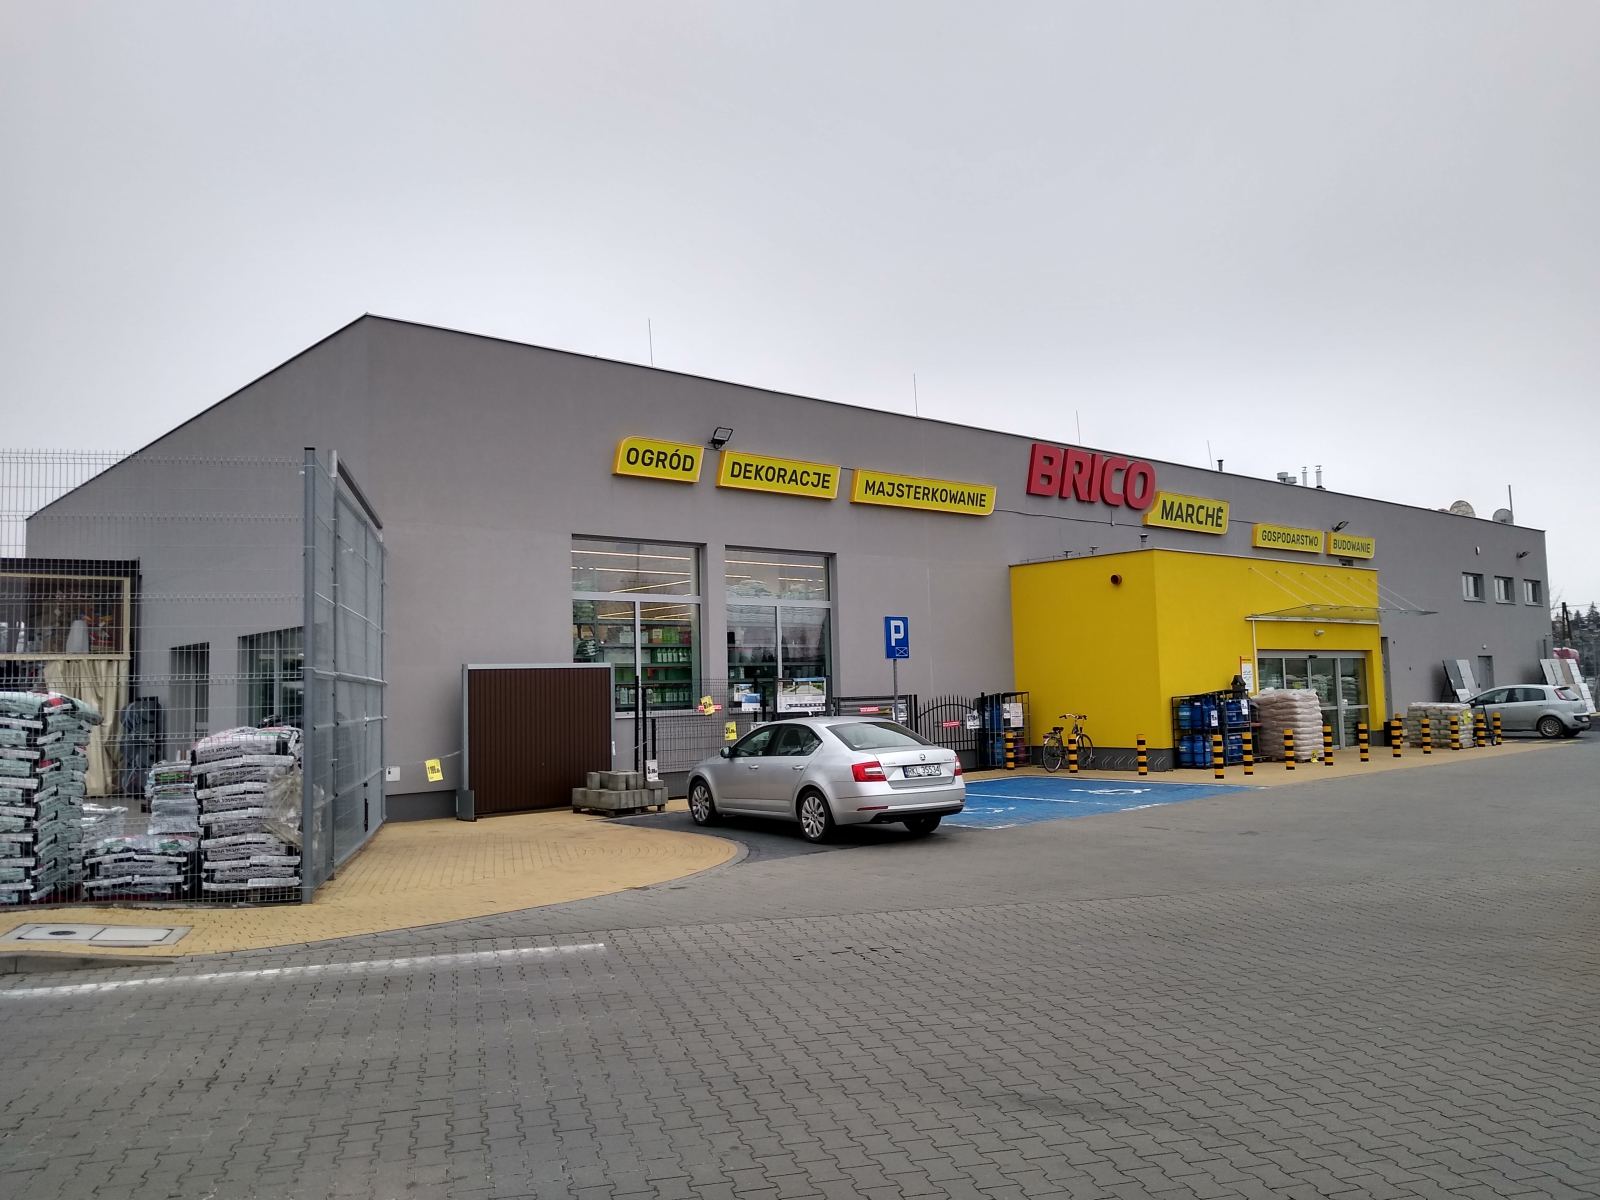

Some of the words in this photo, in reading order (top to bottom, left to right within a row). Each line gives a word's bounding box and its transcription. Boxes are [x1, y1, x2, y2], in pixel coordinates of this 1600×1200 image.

[626, 447, 695, 472] OGRÓD
[730, 461, 832, 490] DEKORACJE
[1026, 443, 1156, 510] BRICO
[864, 479, 987, 508] MAJSTERKOWANIE
[1161, 499, 1224, 528] MARCHÉ
[1261, 530, 1319, 547] GOSPODARSTWO
[1333, 538, 1371, 553] BUDOWANIE
[890, 620, 905, 646] P
